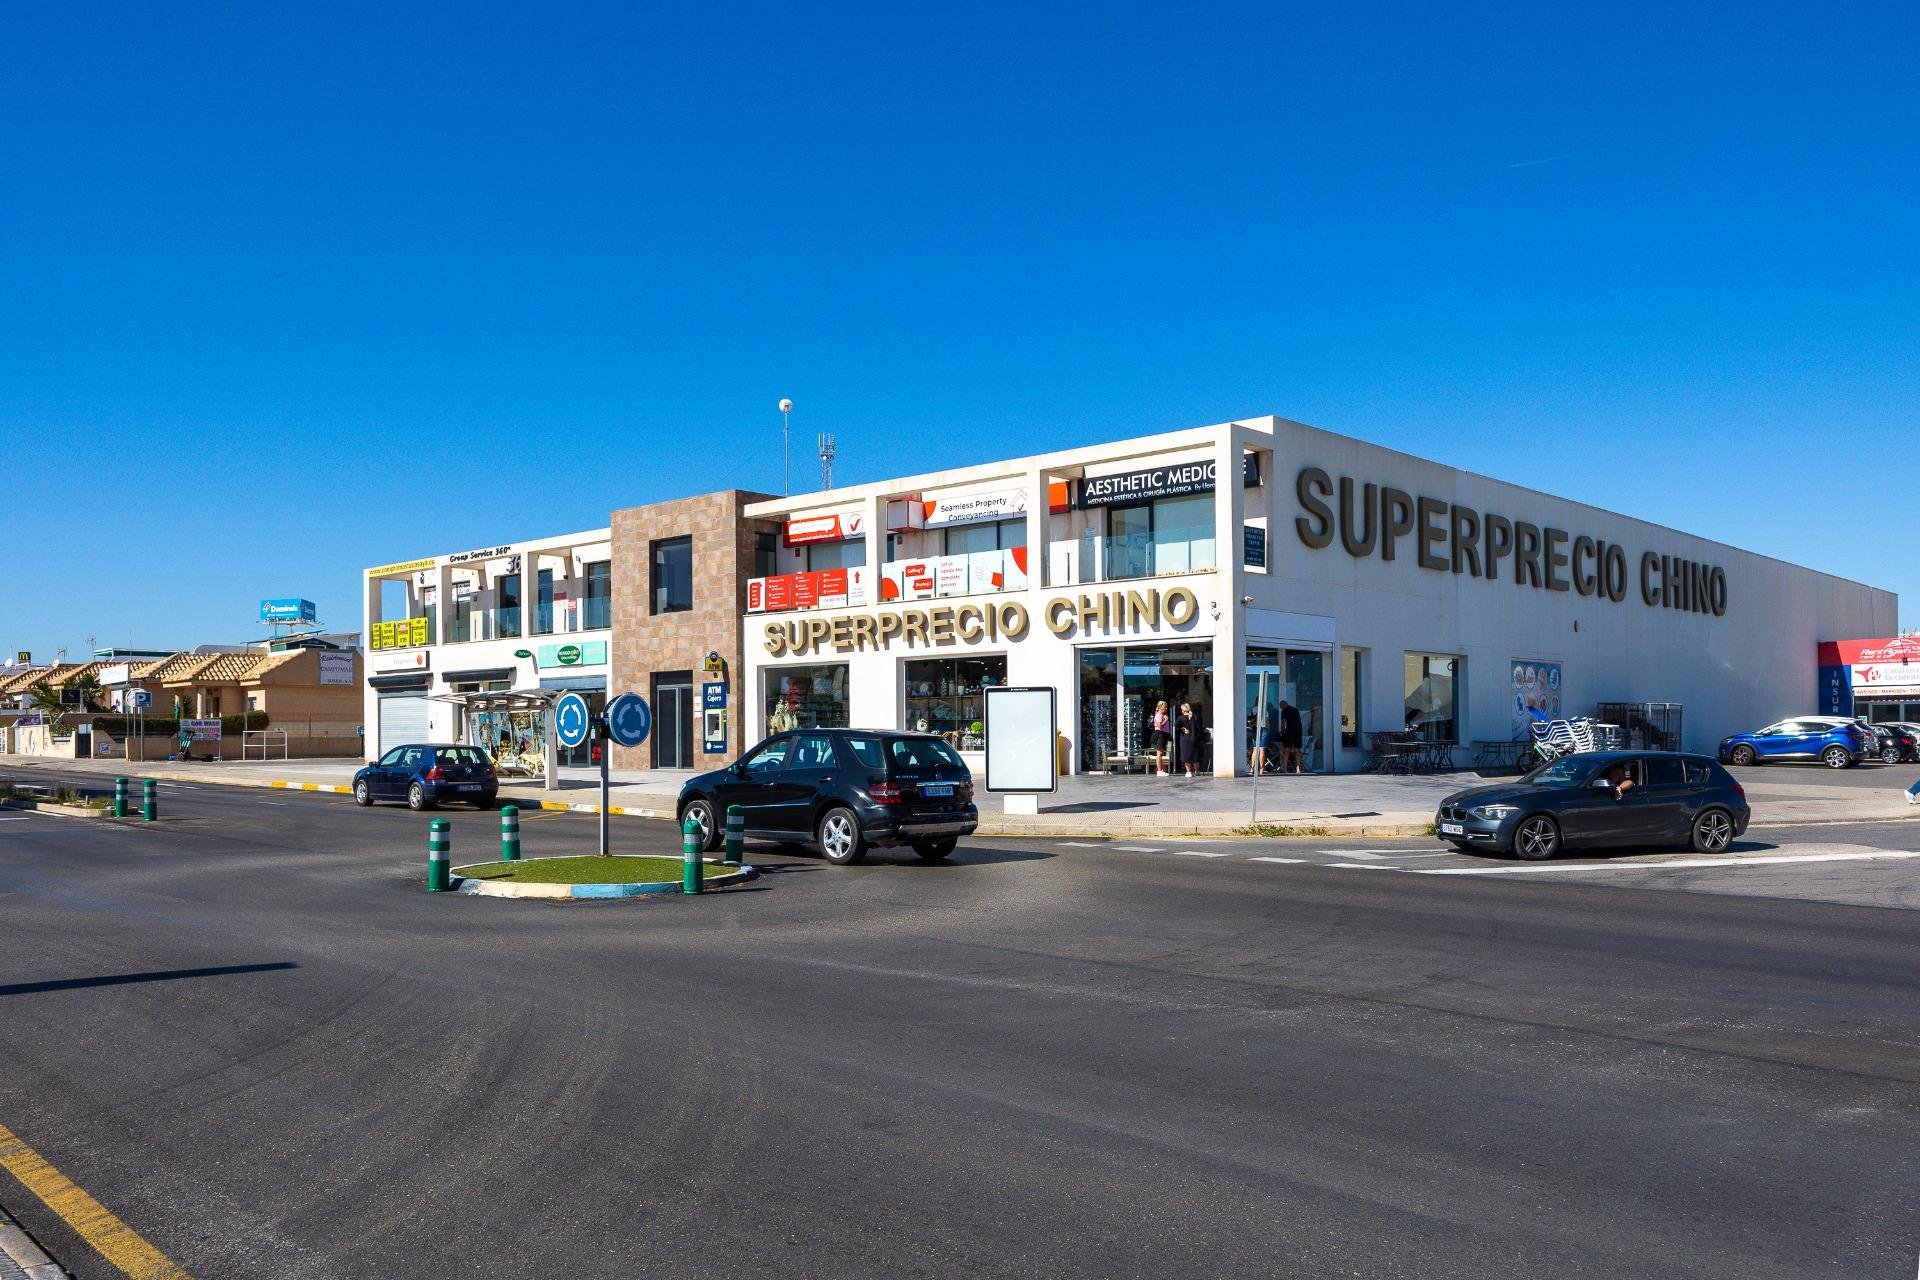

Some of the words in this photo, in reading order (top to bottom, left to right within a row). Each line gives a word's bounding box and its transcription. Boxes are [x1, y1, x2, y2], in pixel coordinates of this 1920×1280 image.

[1085, 472, 1162, 497] AESTHETIC
[1167, 463, 1217, 485] MEDIC
[1087, 497, 1113, 505] MEDICINA
[1113, 493, 1137, 502] ESTÉTICA
[1143, 487, 1166, 498] CIRUGÍA
[1166, 484, 1192, 495] PLÁSTICA
[940, 501, 974, 513] Seamless
[975, 497, 1007, 508] Property
[948, 509, 999, 522] Conveyancing
[1295, 467, 1628, 603] SUPERPRECIO
[1640, 550, 1728, 617] CHINO
[449, 554, 468, 563] Group
[470, 550, 493, 559] Service
[906, 567, 923, 575] Selling?
[270, 604, 298, 613] Domino's
[762, 600, 1031, 655] SUPERPRECIO
[1044, 586, 1198, 635] CHINO
[707, 685, 722, 695] ATM
[137, 693, 146, 702] P
[707, 694, 722, 703] Cajero
